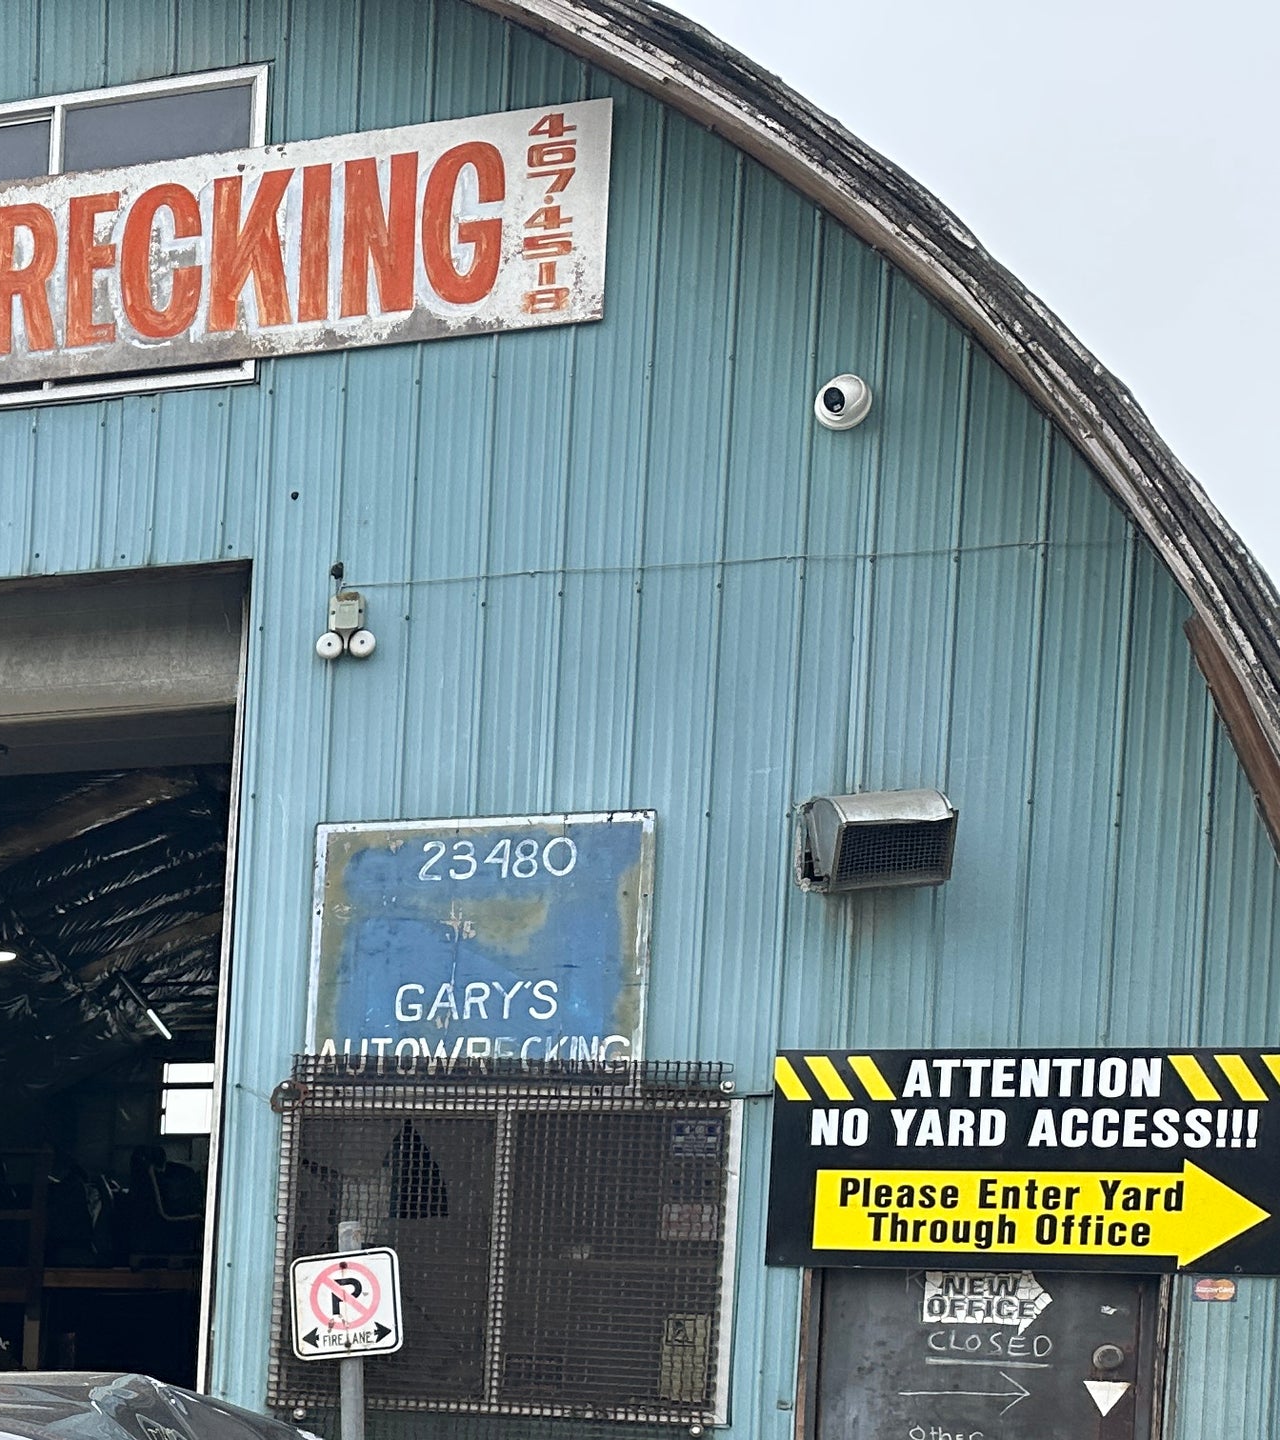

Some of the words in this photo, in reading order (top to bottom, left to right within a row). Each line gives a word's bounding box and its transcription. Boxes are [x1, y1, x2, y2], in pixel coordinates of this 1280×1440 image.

[418, 837, 578, 881] 23480
[395, 980, 558, 1022] GARY'S
[902, 1056, 1162, 1098] ATTENTION
[810, 1108, 869, 1147] NO
[892, 1108, 1006, 1147] YARD
[1028, 1108, 1258, 1149] ACCESS!!!
[839, 1176, 959, 1210] Please
[978, 1178, 1081, 1211] Enter
[1100, 1179, 1184, 1212] Yard
[867, 1211, 1016, 1249] Through
[1035, 1212, 1151, 1246] Office
[943, 1275, 1018, 1296] NEW
[926, 1294, 1036, 1319] OFFICE
[323, 1333, 343, 1347] FIRE
[928, 1330, 1052, 1357] CLOSED
